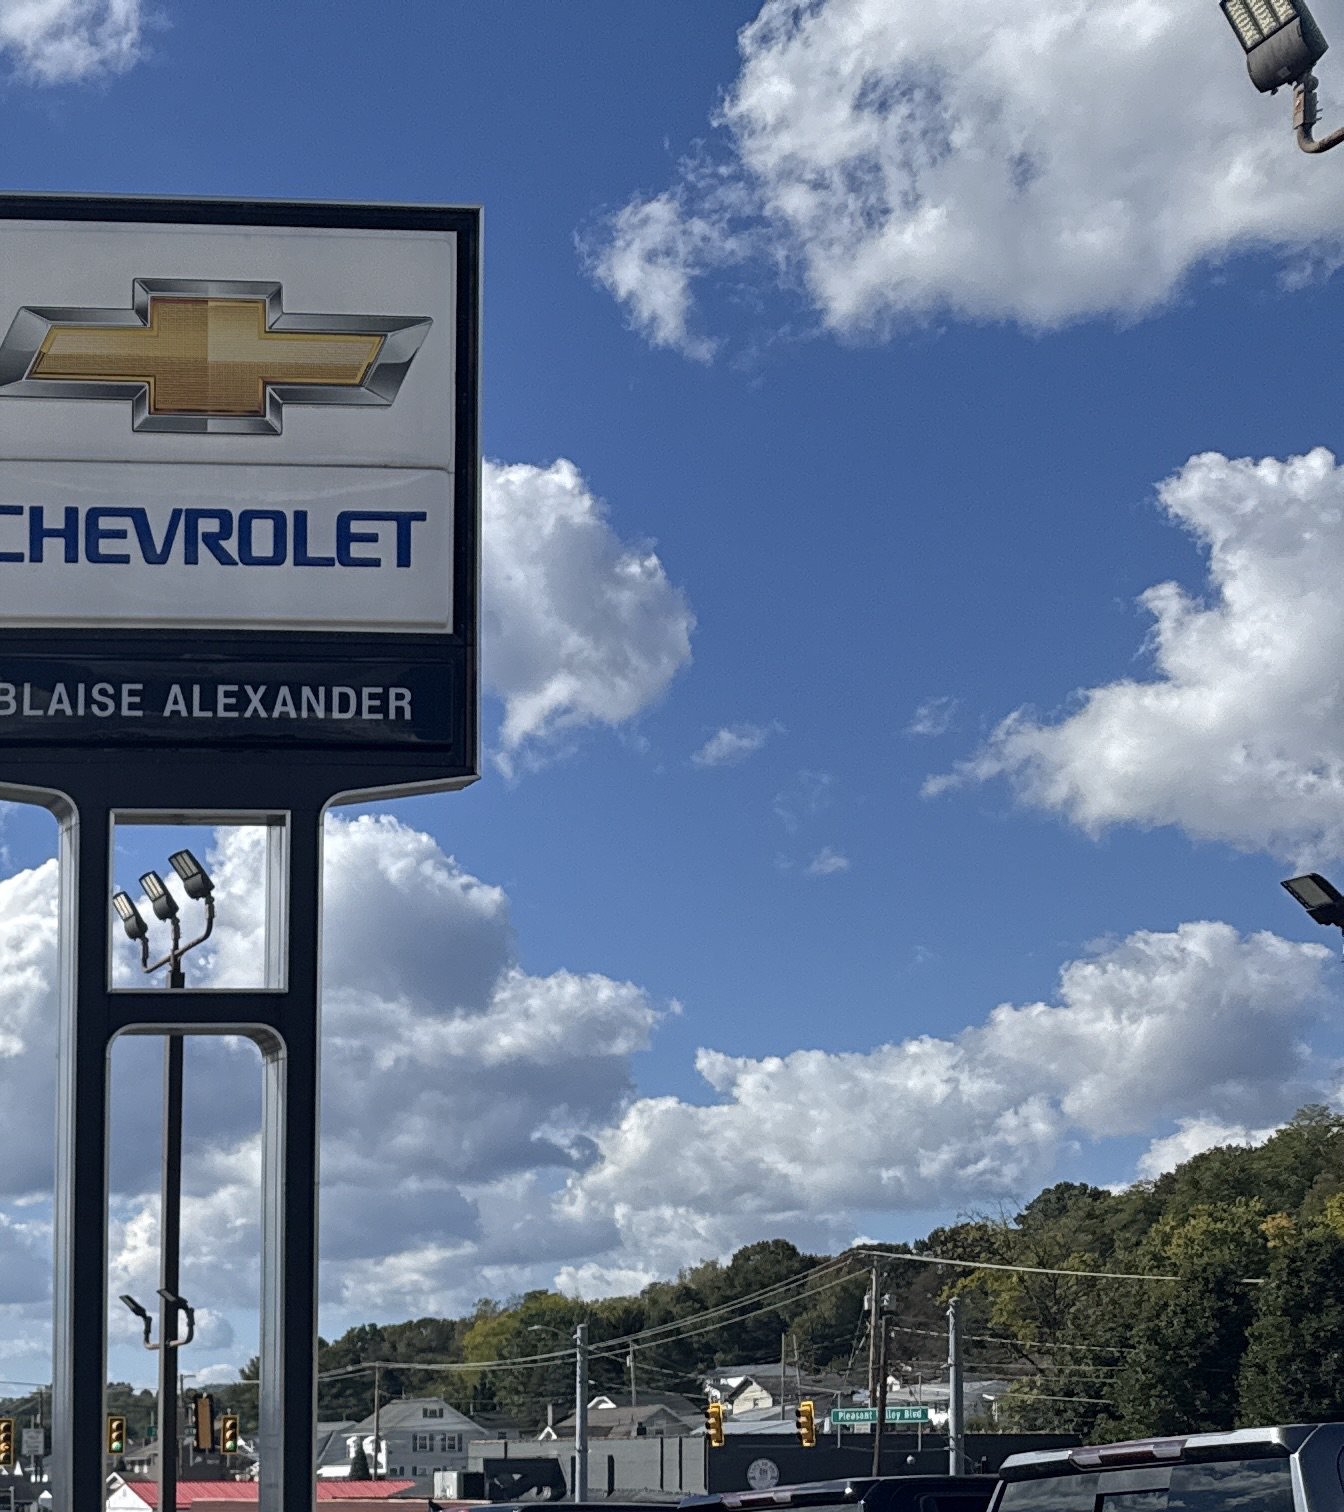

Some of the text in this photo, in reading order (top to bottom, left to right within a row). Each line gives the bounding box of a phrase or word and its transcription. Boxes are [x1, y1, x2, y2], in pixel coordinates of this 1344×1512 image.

[162, 684, 412, 722] ALEXANDER
[838, 1410, 873, 1421] Pleasant
[904, 1408, 922, 1419] Blvd
